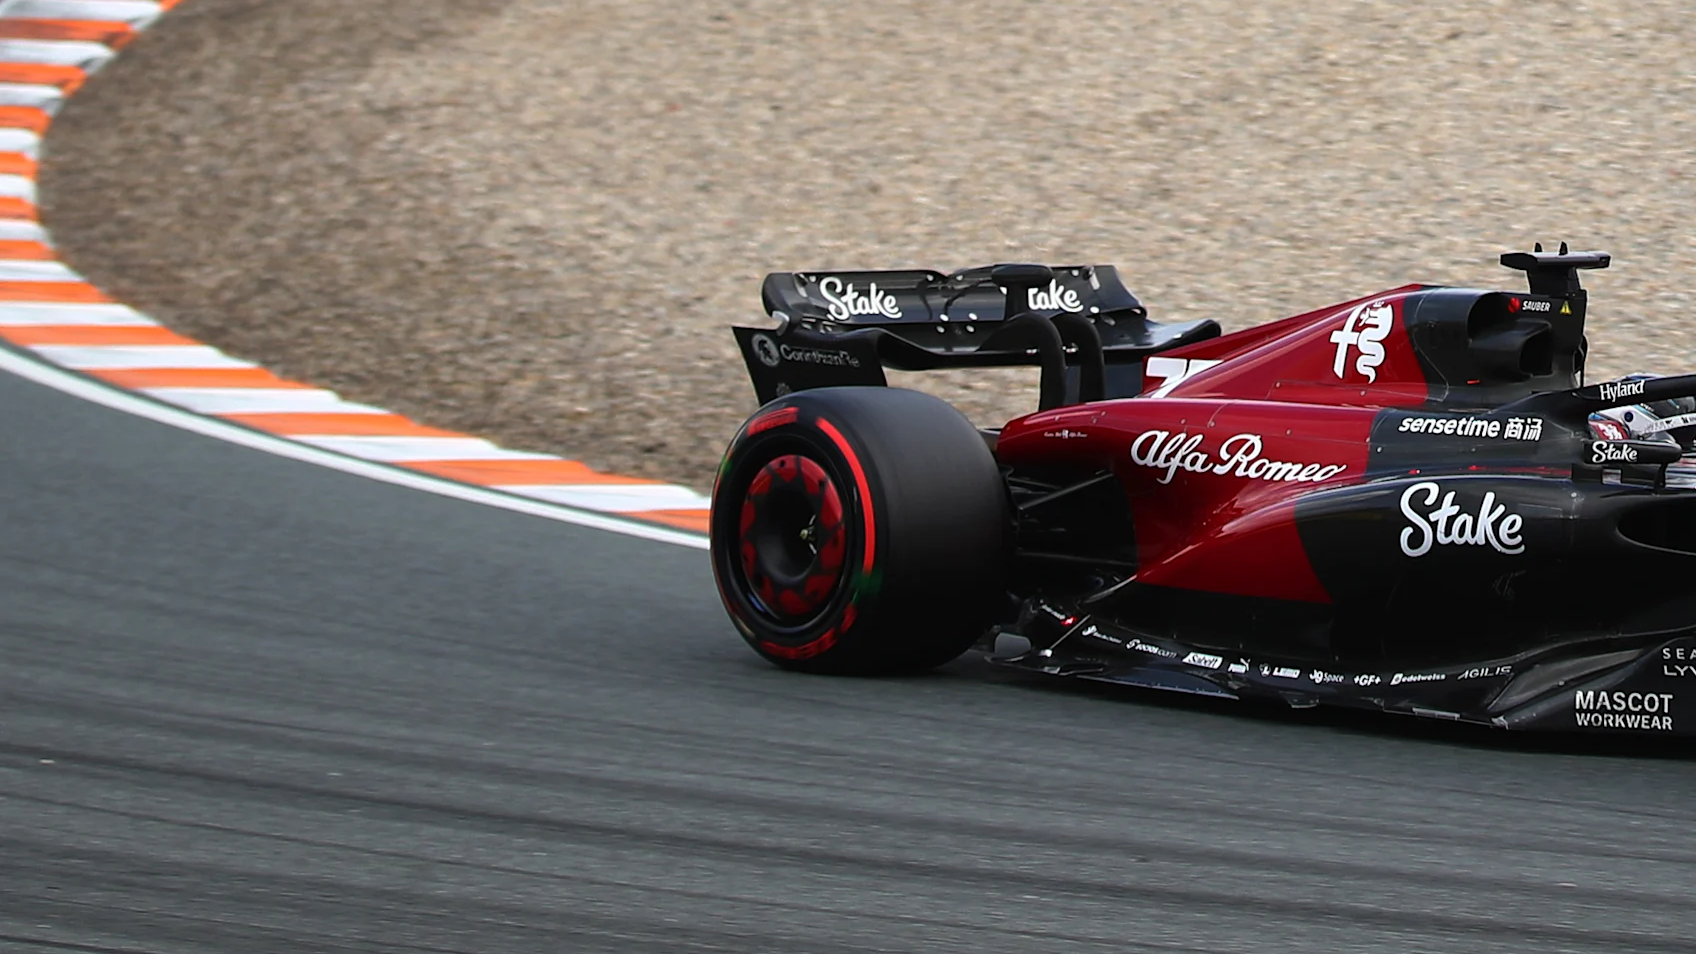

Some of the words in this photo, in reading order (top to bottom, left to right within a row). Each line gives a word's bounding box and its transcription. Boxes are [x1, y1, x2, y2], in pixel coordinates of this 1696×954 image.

[819, 276, 903, 321] Stake
[1522, 300, 1551, 312] SAUBER
[1600, 380, 1645, 402] Hyland
[1398, 416, 1501, 438] sensetime
[1504, 417, 1543, 441] 商汤
[1131, 430, 1214, 485] Alfa
[1213, 434, 1347, 482] Romeo
[1591, 441, 1638, 463] Stake
[1400, 482, 1526, 557] Stake
[1575, 690, 1673, 713] MASCOT
[1575, 713, 1673, 730] WORKWEAR
